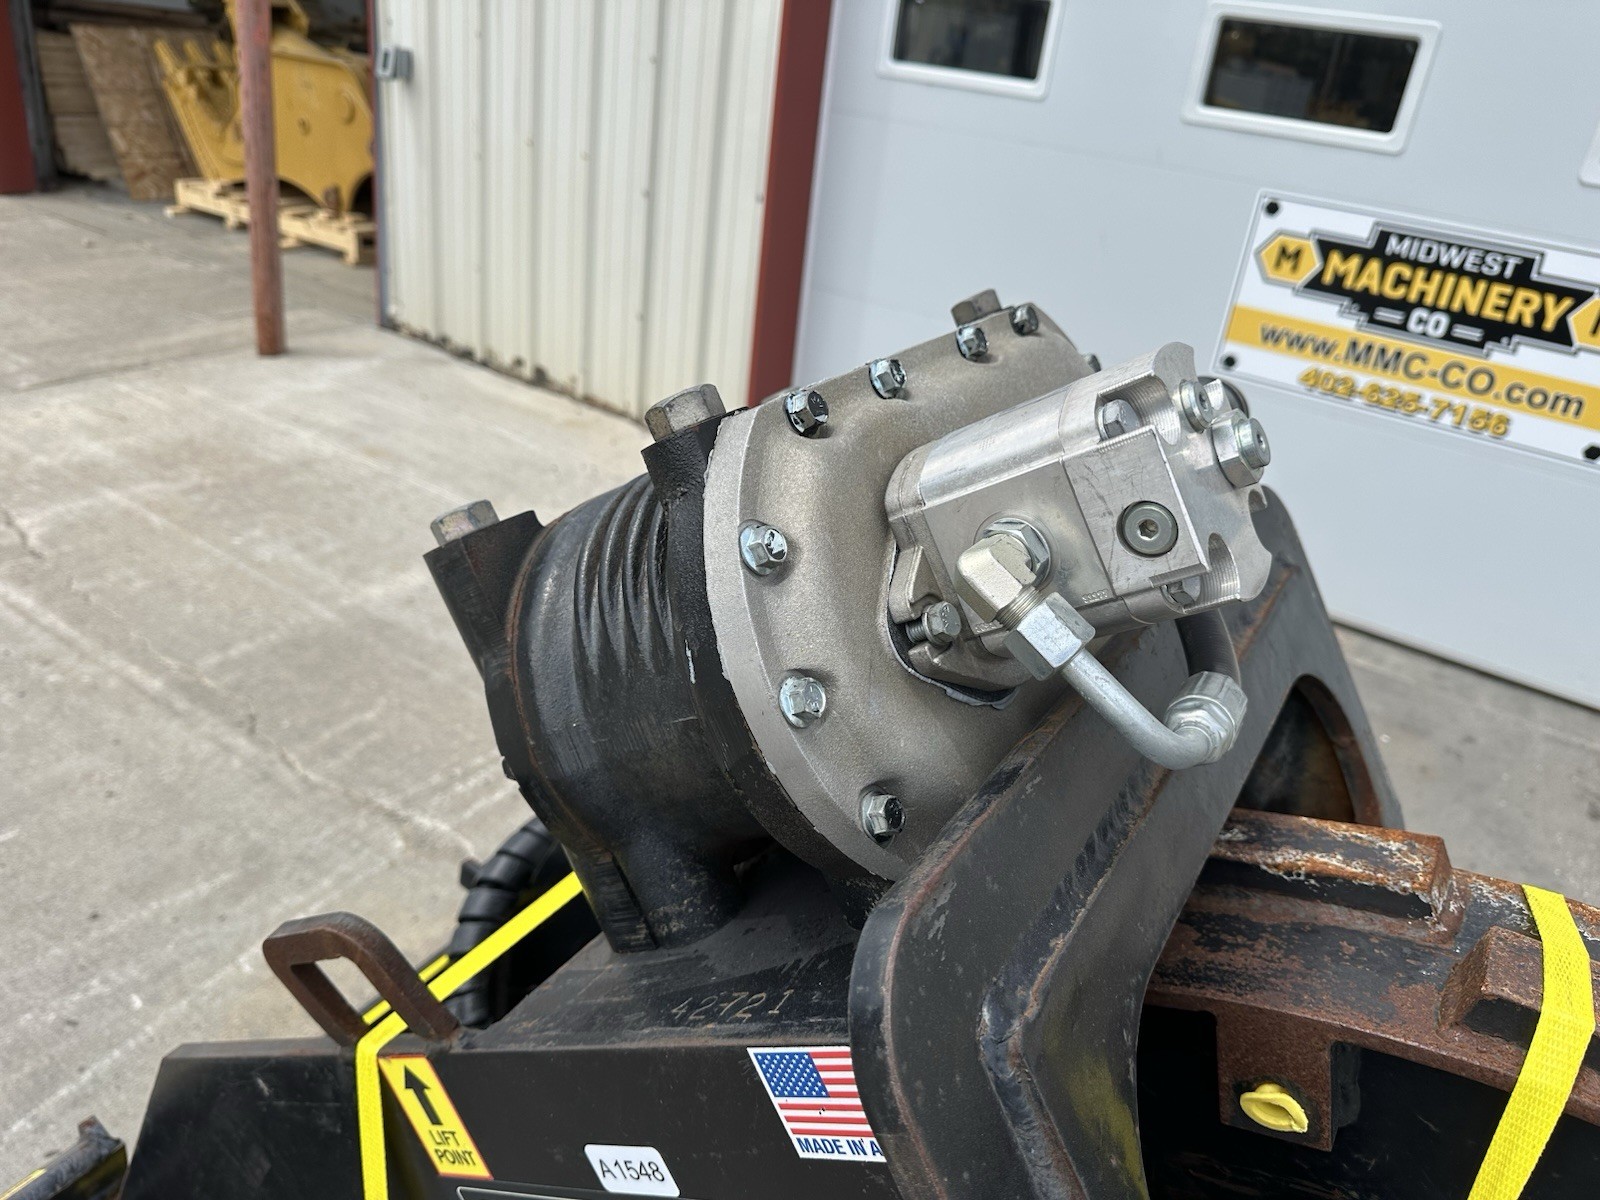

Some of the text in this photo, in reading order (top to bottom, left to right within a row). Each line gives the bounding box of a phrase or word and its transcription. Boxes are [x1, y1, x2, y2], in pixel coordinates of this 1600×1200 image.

[1271, 244, 1305, 275] M
[1384, 232, 1523, 279] MIDWEST
[1320, 249, 1576, 333] MACHINERY
[1406, 307, 1451, 338] CO
[1259, 322, 1585, 419] www.MMC-CO.com
[428, 1129, 461, 1146] LIFT
[795, 1137, 847, 1155] MADE
[845, 1139, 868, 1156] IN
[434, 1148, 476, 1166] POINT
[599, 1158, 665, 1182] A1548
